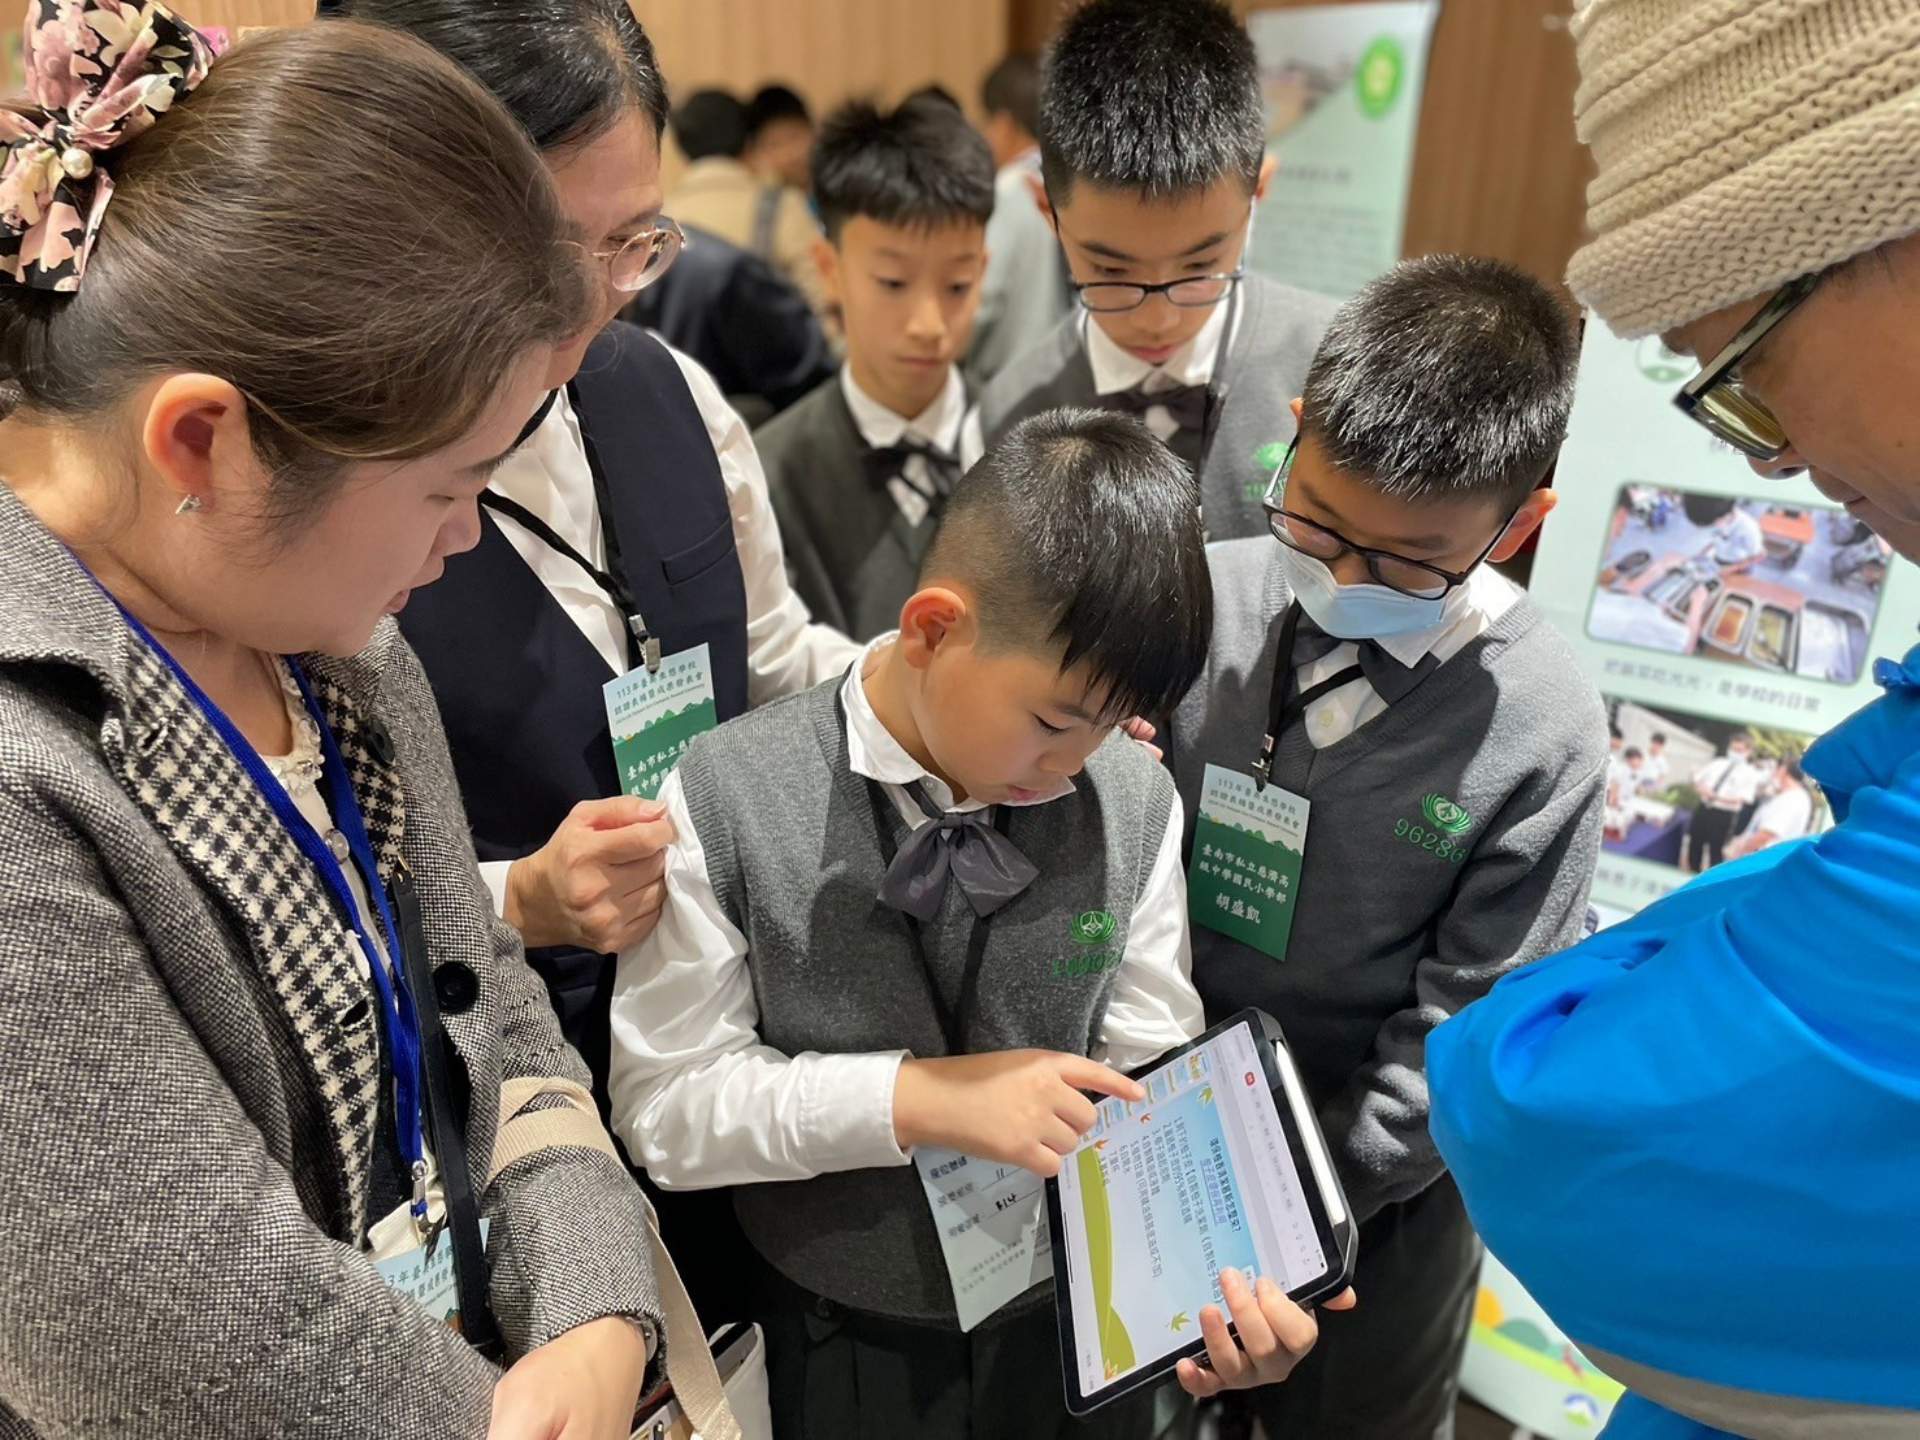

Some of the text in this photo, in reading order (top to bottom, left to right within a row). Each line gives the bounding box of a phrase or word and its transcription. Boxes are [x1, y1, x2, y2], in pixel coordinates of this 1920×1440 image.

[1202, 844, 1290, 888] 臺南市私立慈濟高
